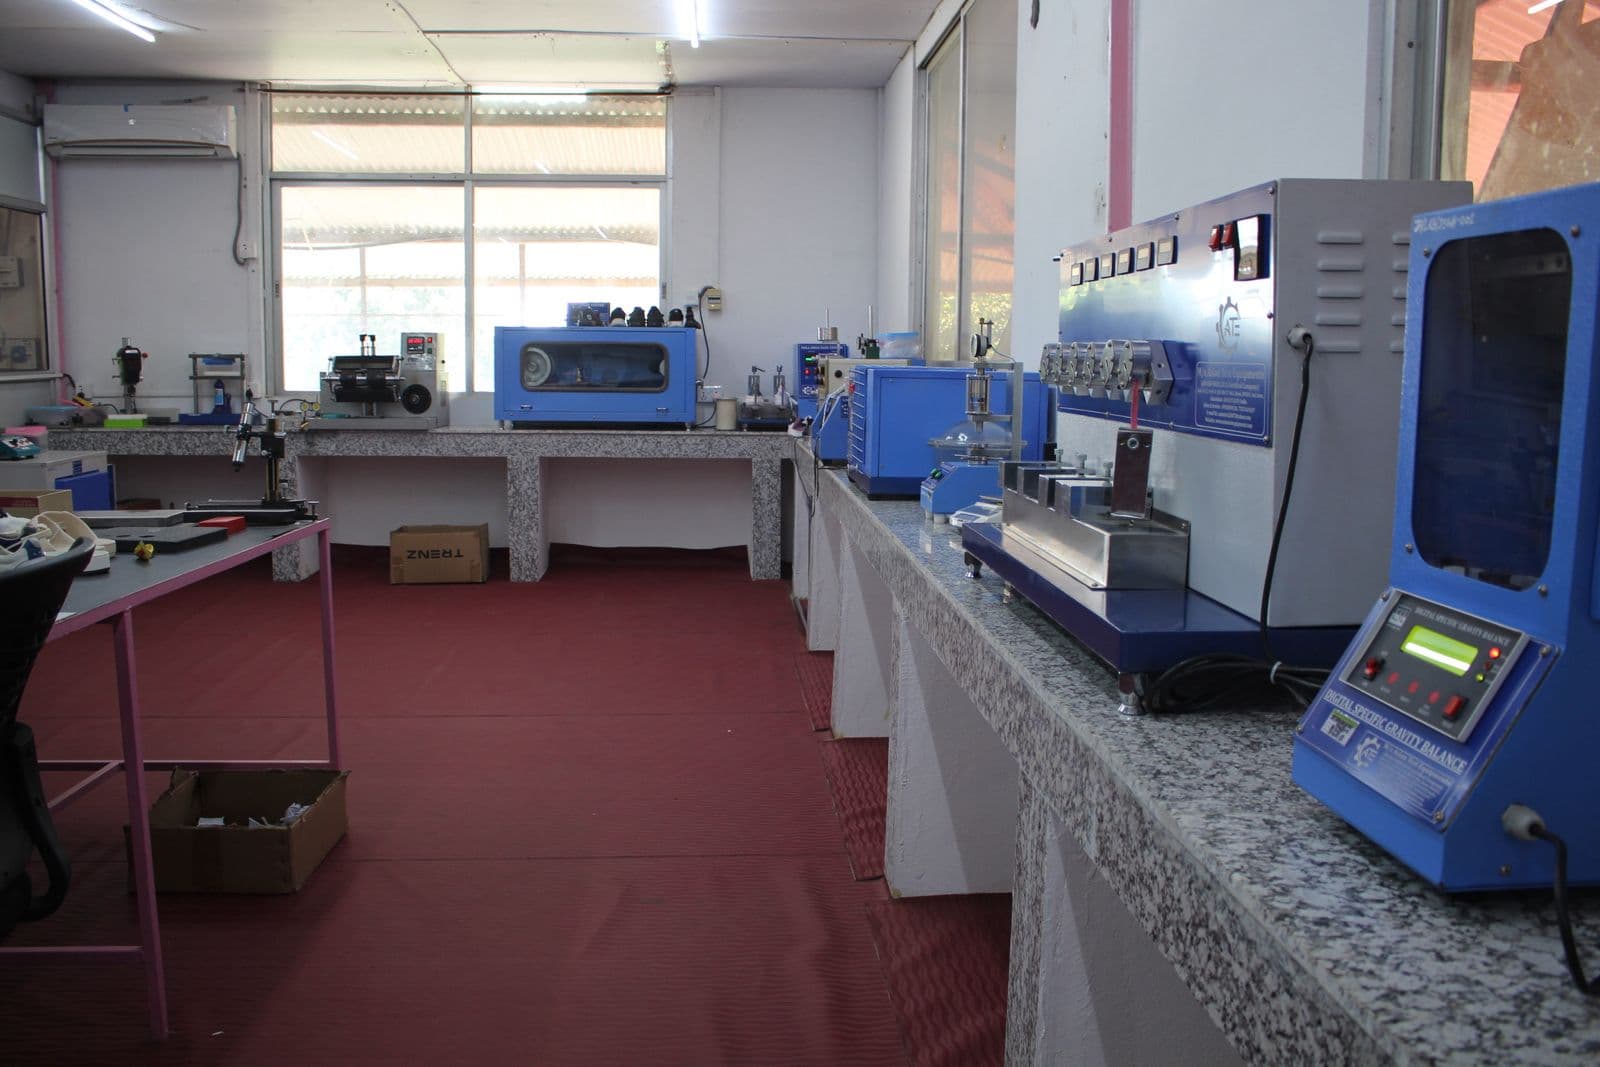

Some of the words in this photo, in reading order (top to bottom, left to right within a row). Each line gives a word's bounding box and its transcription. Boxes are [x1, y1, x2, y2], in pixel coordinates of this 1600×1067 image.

[406, 548, 464, 560] TRENZ
[1323, 689, 1354, 711] DIGITAL
[1352, 703, 1388, 729] SPECIFIC
[1384, 721, 1424, 749] GRAVITY
[1420, 740, 1467, 774] BALANCE
